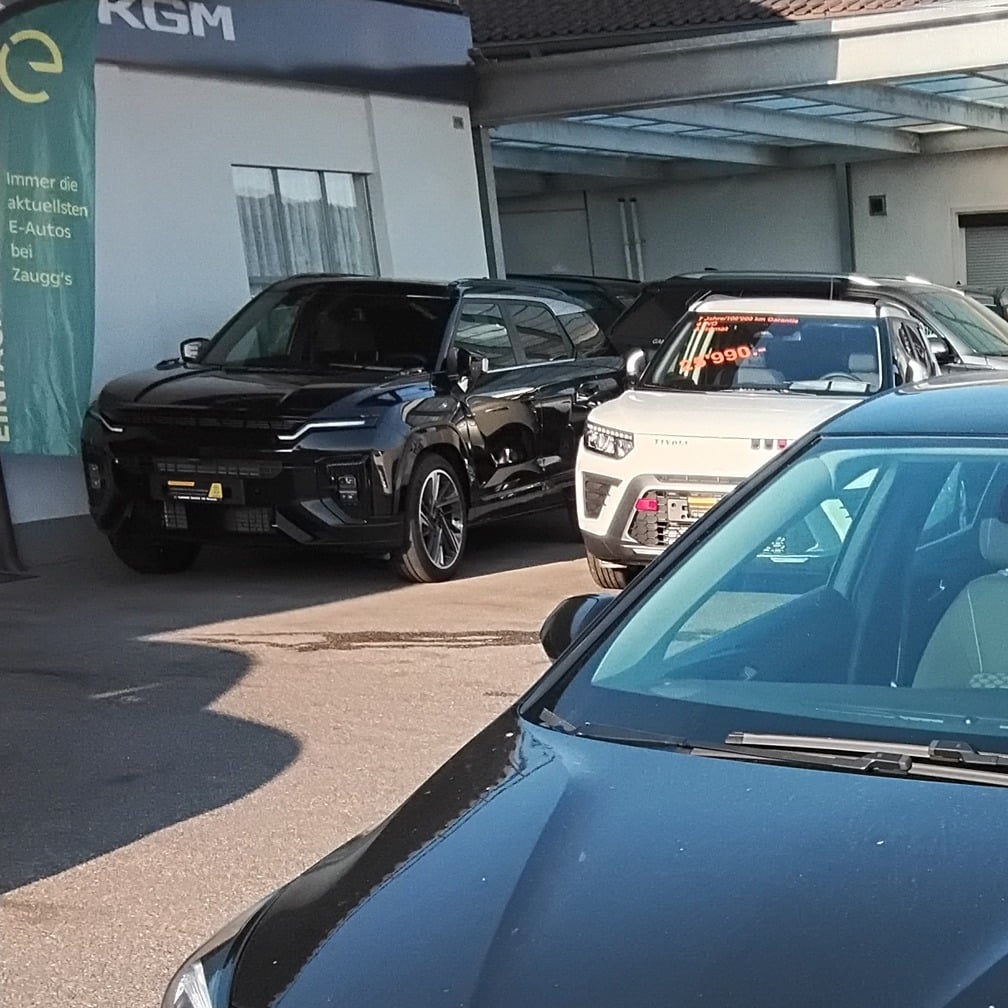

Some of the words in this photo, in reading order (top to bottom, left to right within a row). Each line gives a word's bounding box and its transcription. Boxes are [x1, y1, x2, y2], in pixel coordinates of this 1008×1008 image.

[97, 0, 235, 41] KGM
[6, 172, 56, 189] Immer
[60, 176, 78, 192] die
[8, 195, 88, 217] aktuellsten
[9, 220, 71, 238] E-Autos
[11, 243, 33, 258] bei
[12, 267, 73, 287] Zaugg's
